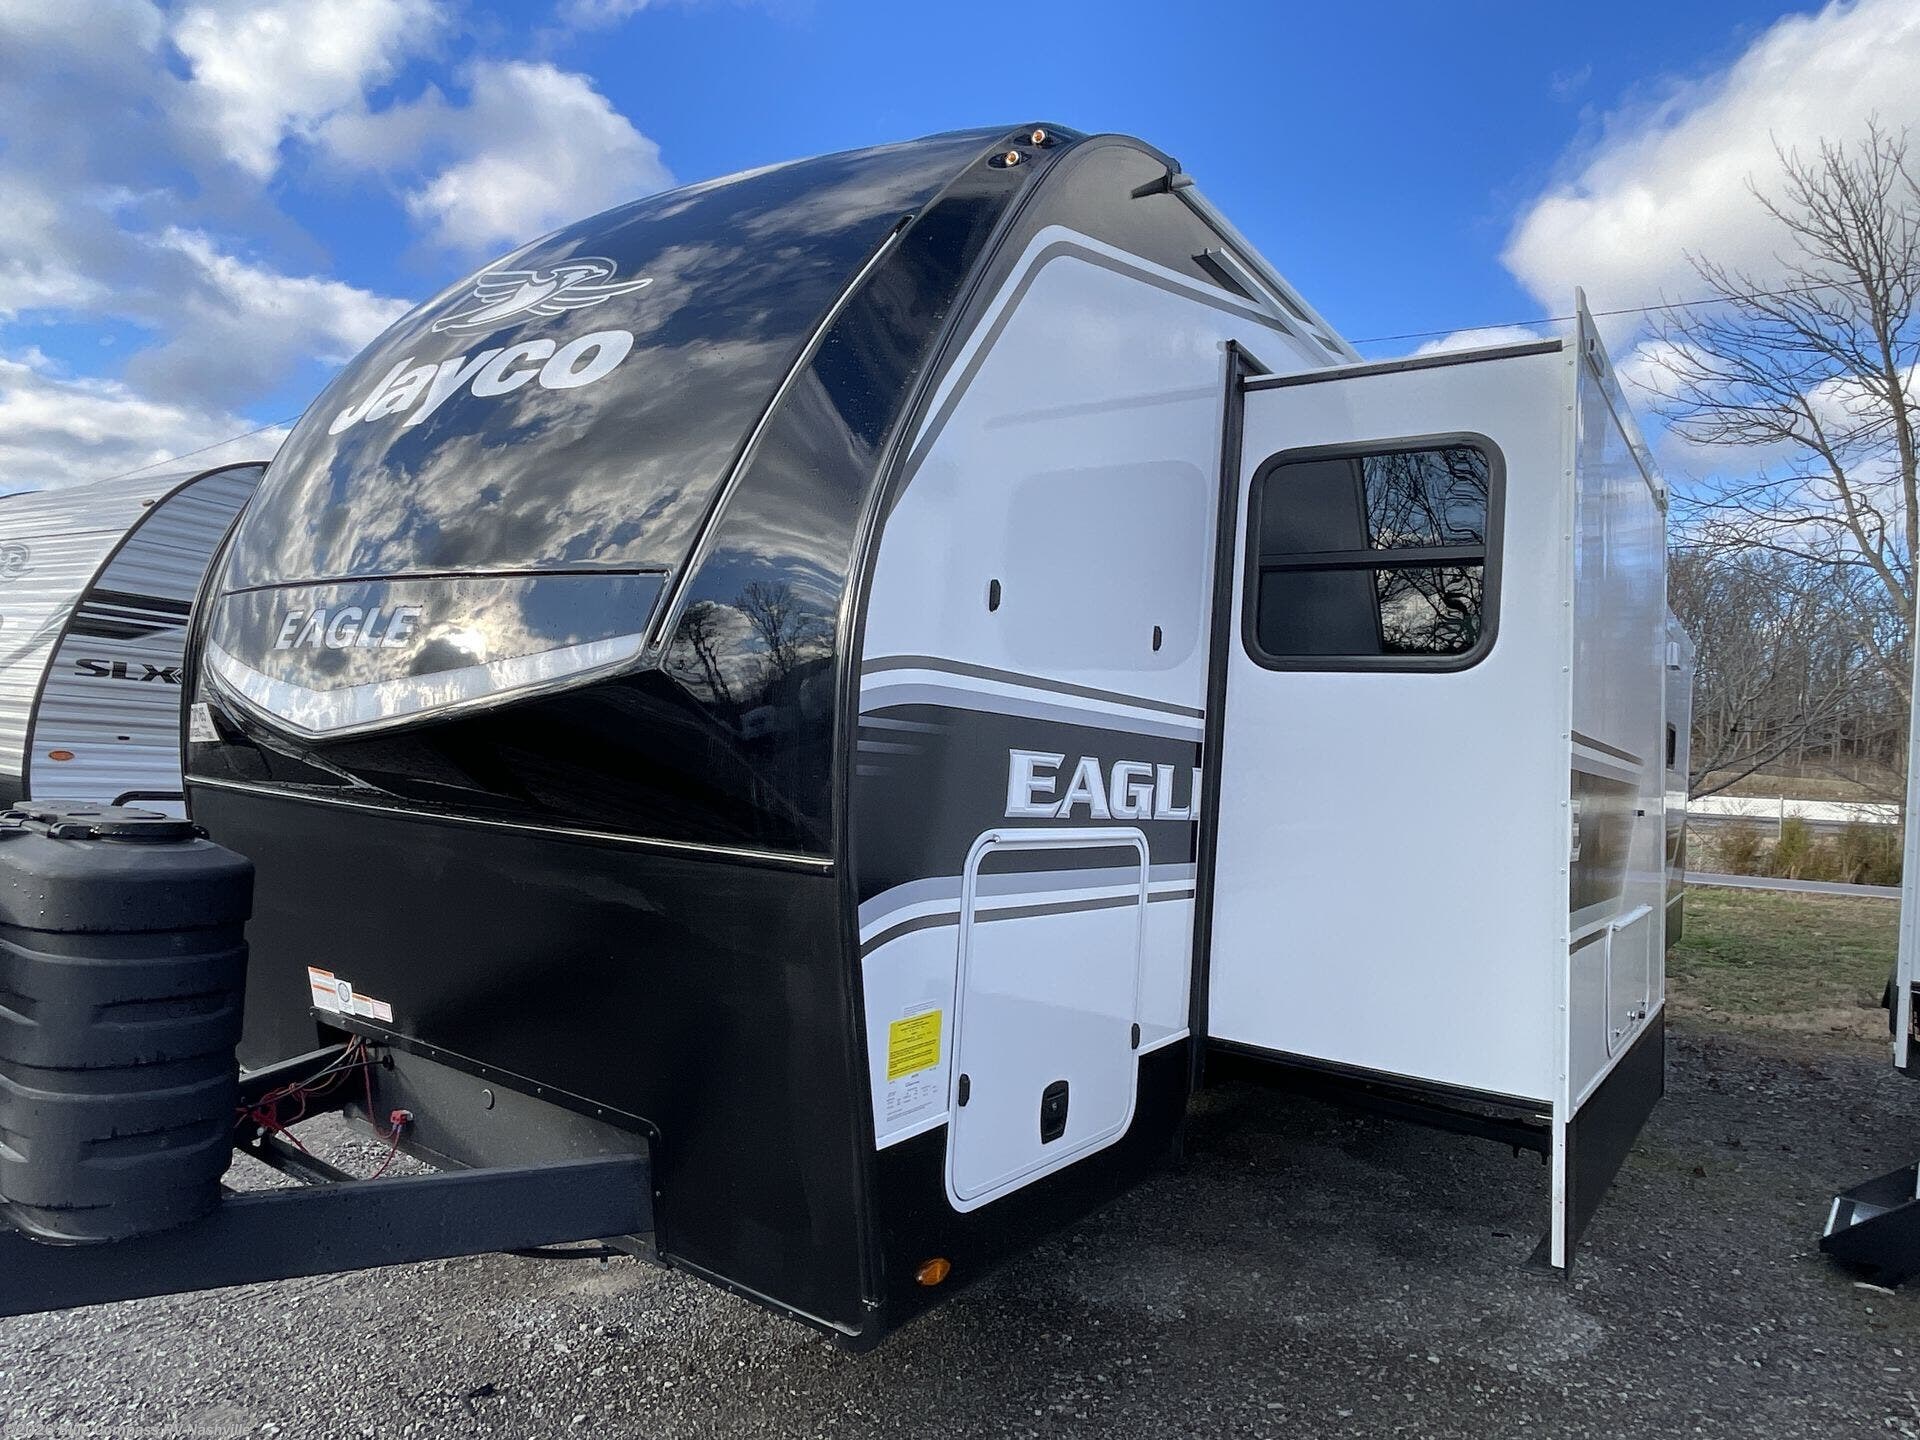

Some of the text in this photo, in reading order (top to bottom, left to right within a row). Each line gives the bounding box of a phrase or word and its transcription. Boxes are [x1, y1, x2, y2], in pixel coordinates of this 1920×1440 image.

[329, 330, 634, 435] Jayco
[274, 605, 423, 650] EAGLE
[75, 658, 182, 685] SLX
[1004, 748, 1202, 820] EAGL
